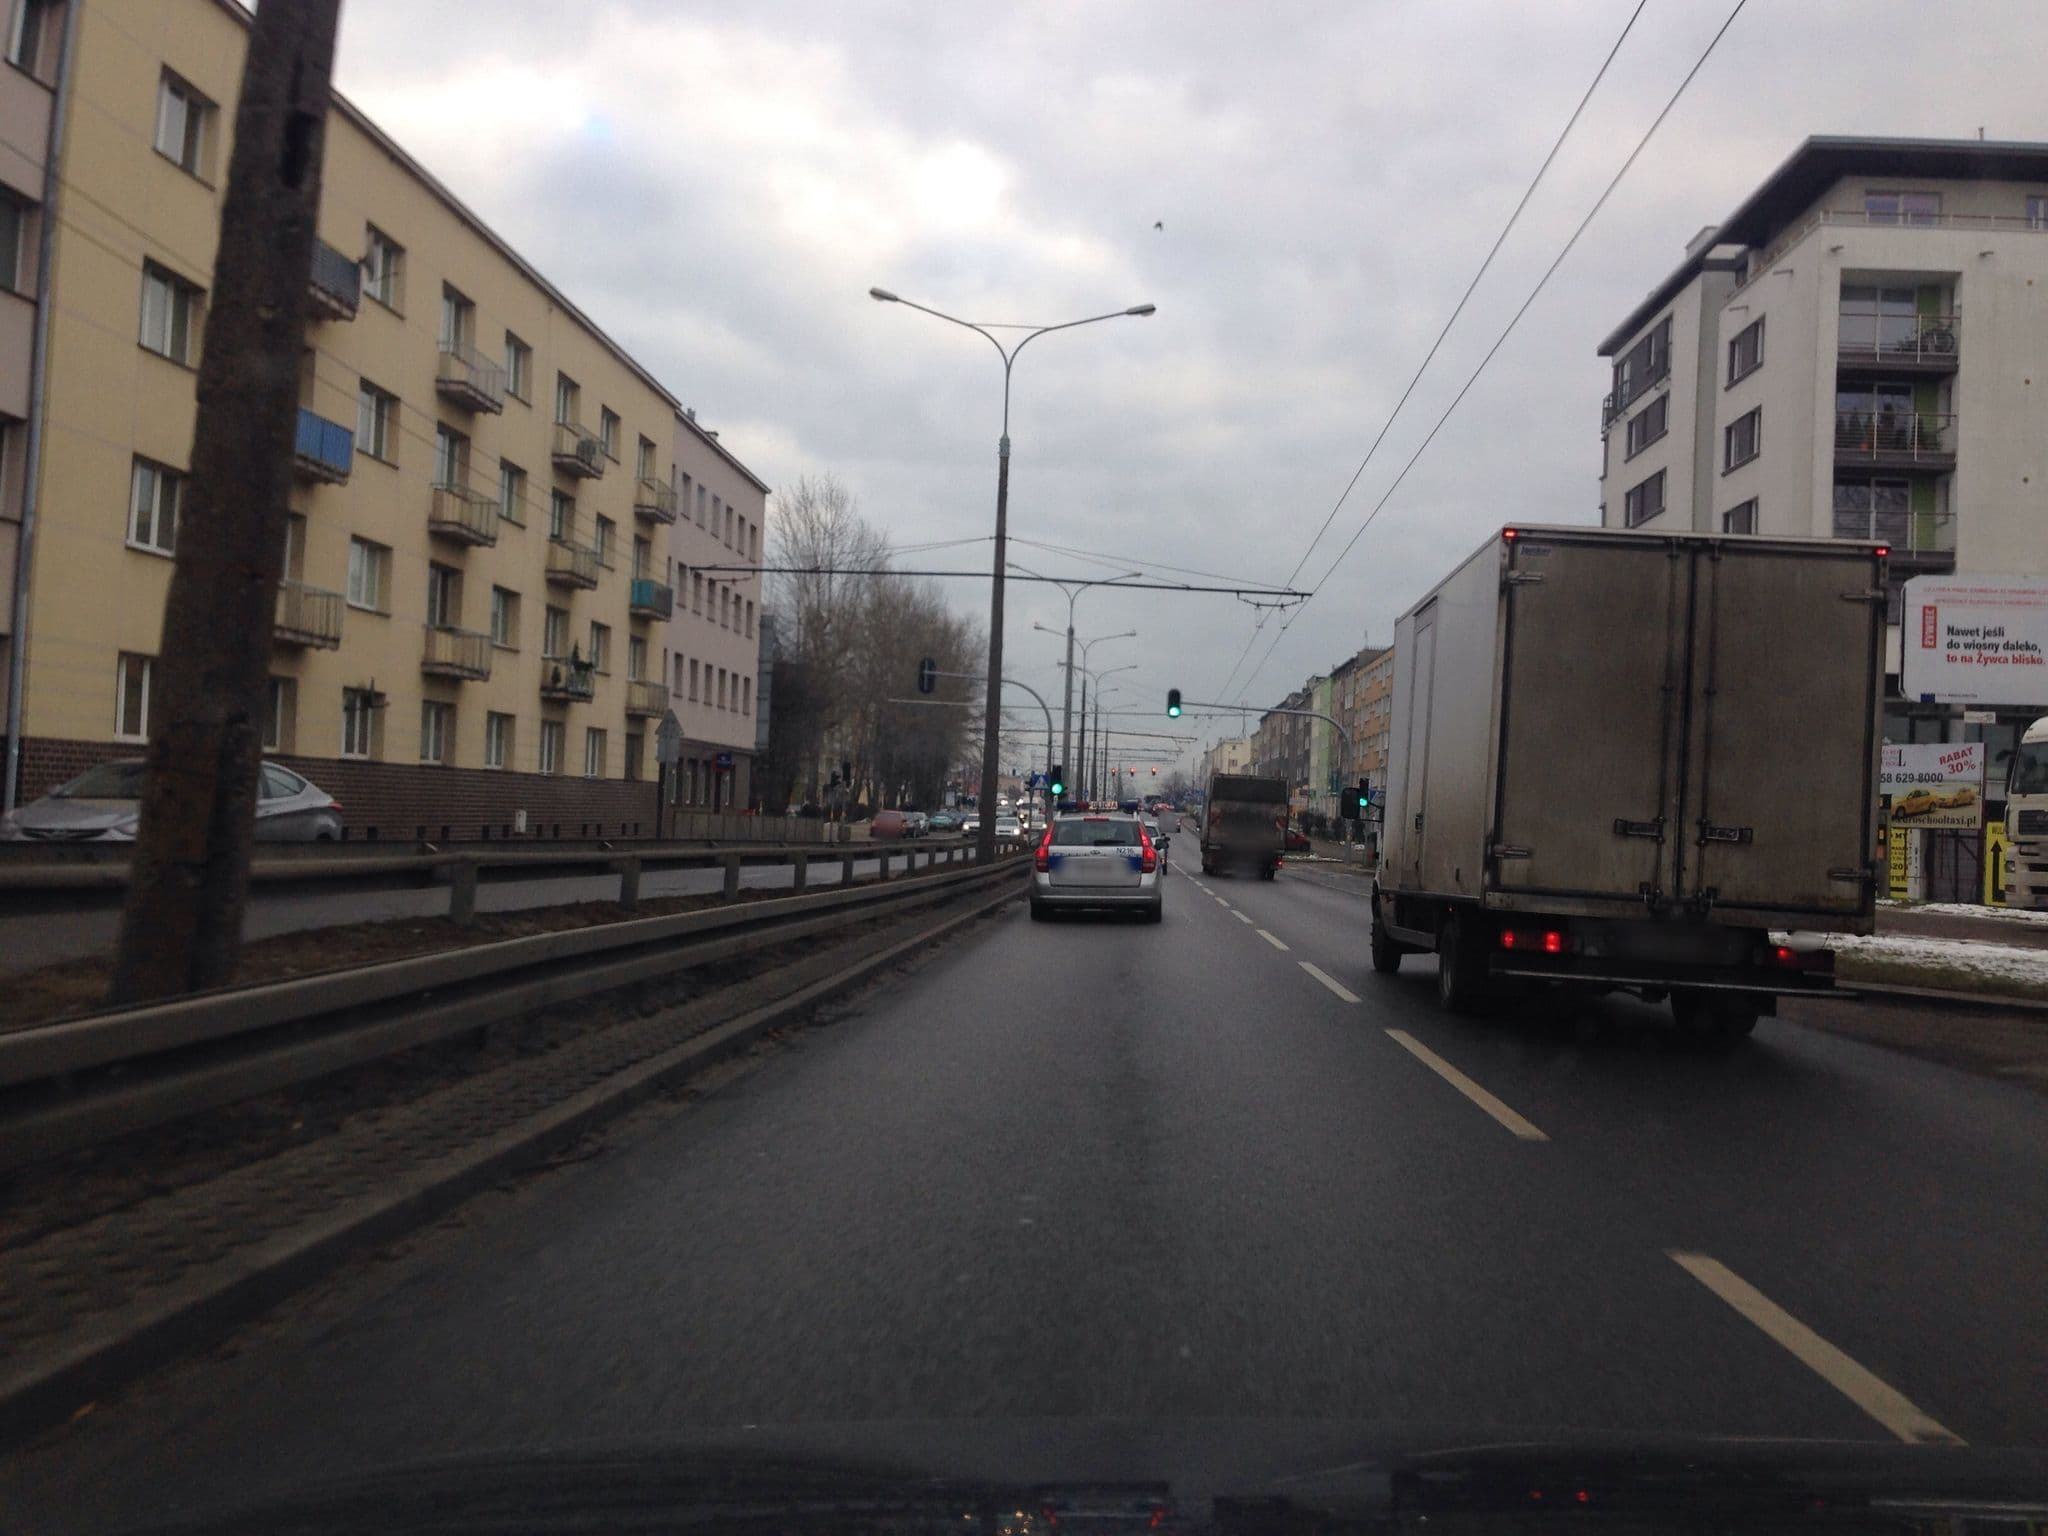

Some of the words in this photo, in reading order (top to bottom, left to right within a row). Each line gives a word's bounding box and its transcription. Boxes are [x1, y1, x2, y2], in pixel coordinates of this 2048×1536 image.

[1947, 625, 1979, 637] Nawet
[1983, 626, 2005, 640] jeśli
[1946, 639, 1960, 650] do
[1963, 641, 2000, 653] wiosny
[2003, 641, 2041, 654] daleko,
[1946, 654, 1958, 663] to
[1960, 655, 1973, 664] na
[1976, 651, 2009, 666] Żywca
[1939, 746, 1973, 765] RABAT
[1948, 760, 1976, 775] 30%
